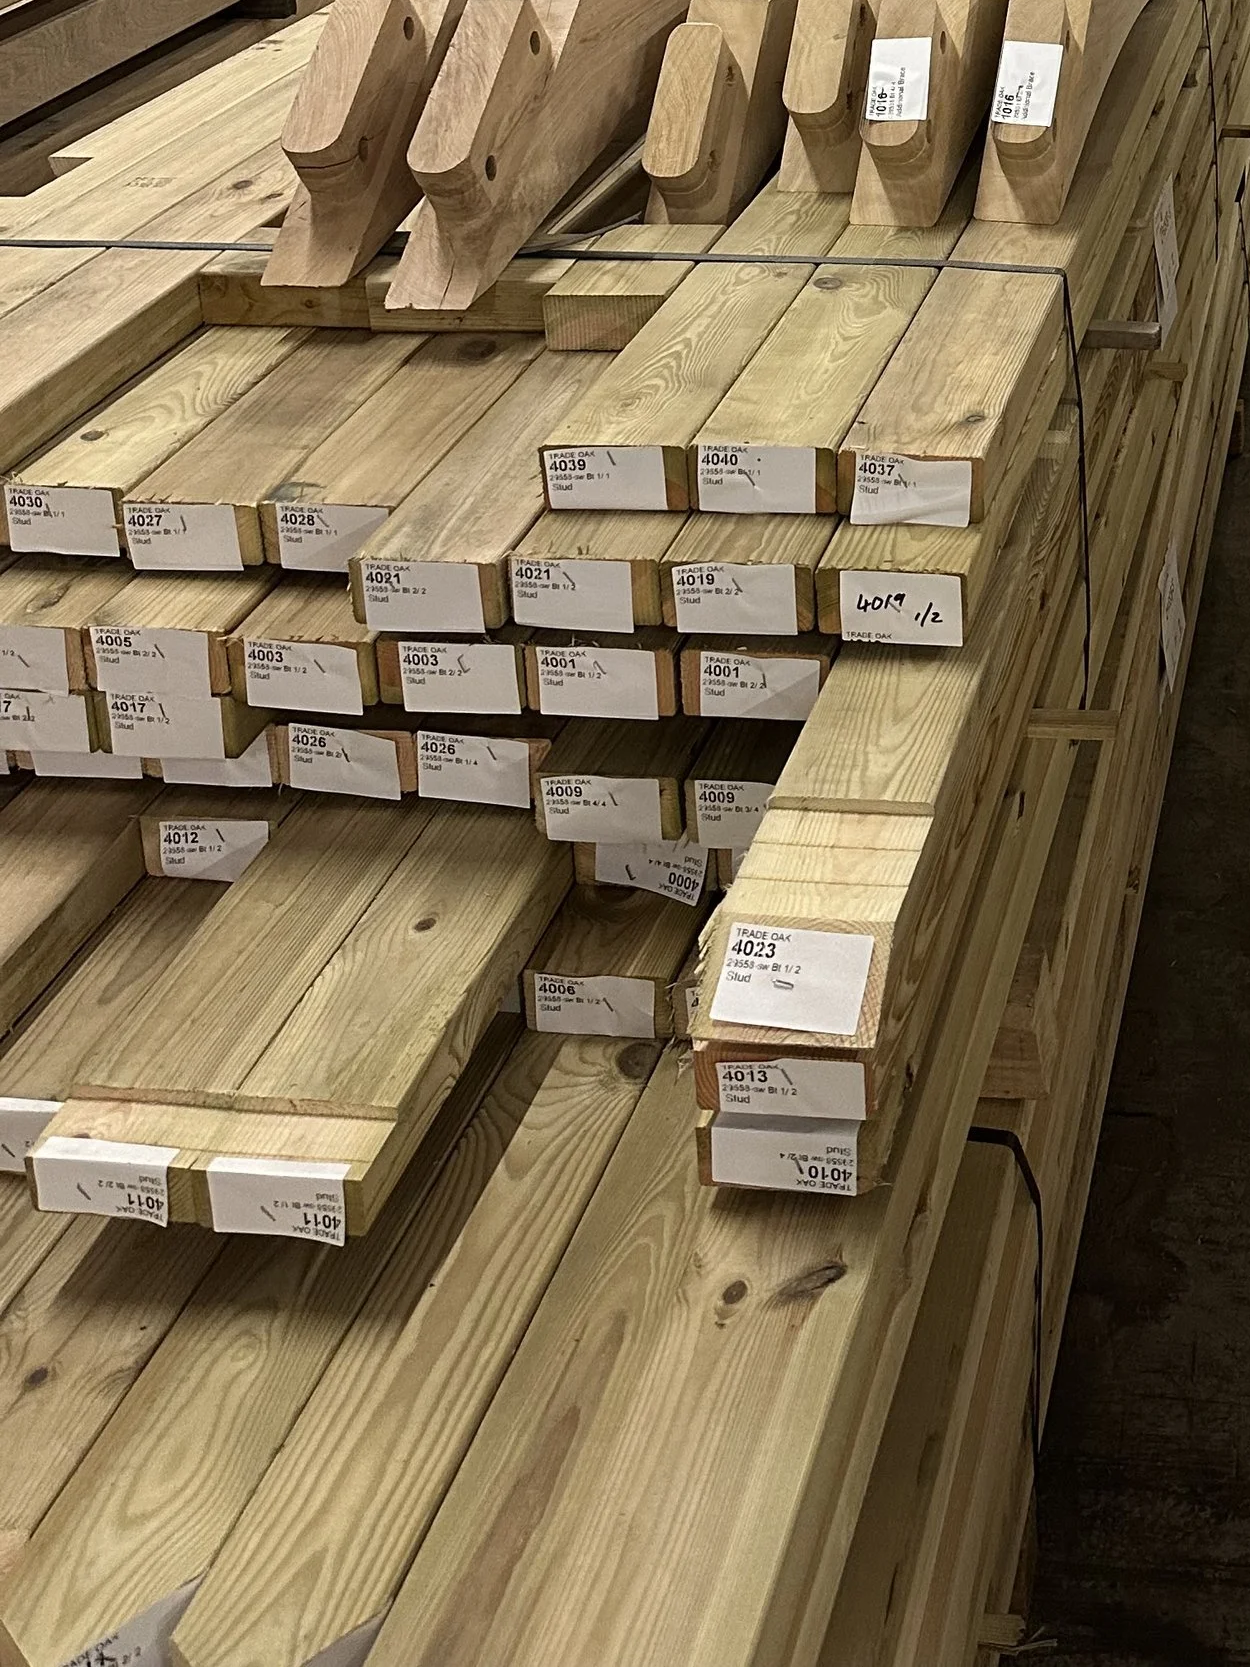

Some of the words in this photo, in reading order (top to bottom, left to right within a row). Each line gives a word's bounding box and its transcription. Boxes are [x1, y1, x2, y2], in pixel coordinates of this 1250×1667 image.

[1001, 94, 1014, 120] 1016
[549, 458, 586, 472] 4039
[701, 453, 738, 466] 4040
[858, 462, 895, 476] 4037
[9, 495, 43, 508] 4030
[128, 514, 162, 527] 4027
[280, 513, 315, 526] 4028
[365, 571, 401, 584] 4021
[515, 566, 550, 581] 4021
[676, 573, 715, 587] 4019
[914, 601, 943, 627] 1/2
[95, 635, 132, 648] 4005
[247, 649, 284, 663] 4003
[403, 653, 439, 666] 4003
[541, 656, 576, 669] 4001
[703, 664, 739, 678] 4001
[111, 701, 146, 714] 4017
[292, 733, 327, 748] 4026
[420, 741, 456, 755] 4026
[546, 785, 582, 798] 4009
[699, 790, 735, 803] 4009
[163, 831, 199, 845] 4012
[736, 927, 768, 940] TRADE
[771, 932, 792, 943] OAK
[731, 939, 776, 959] 4023
[726, 970, 752, 983] Stud
[722, 1069, 768, 1083] 4013
[808, 1165, 853, 1183] 4010
[127, 1193, 165, 1211] 4011
[303, 1212, 342, 1230] 4011
